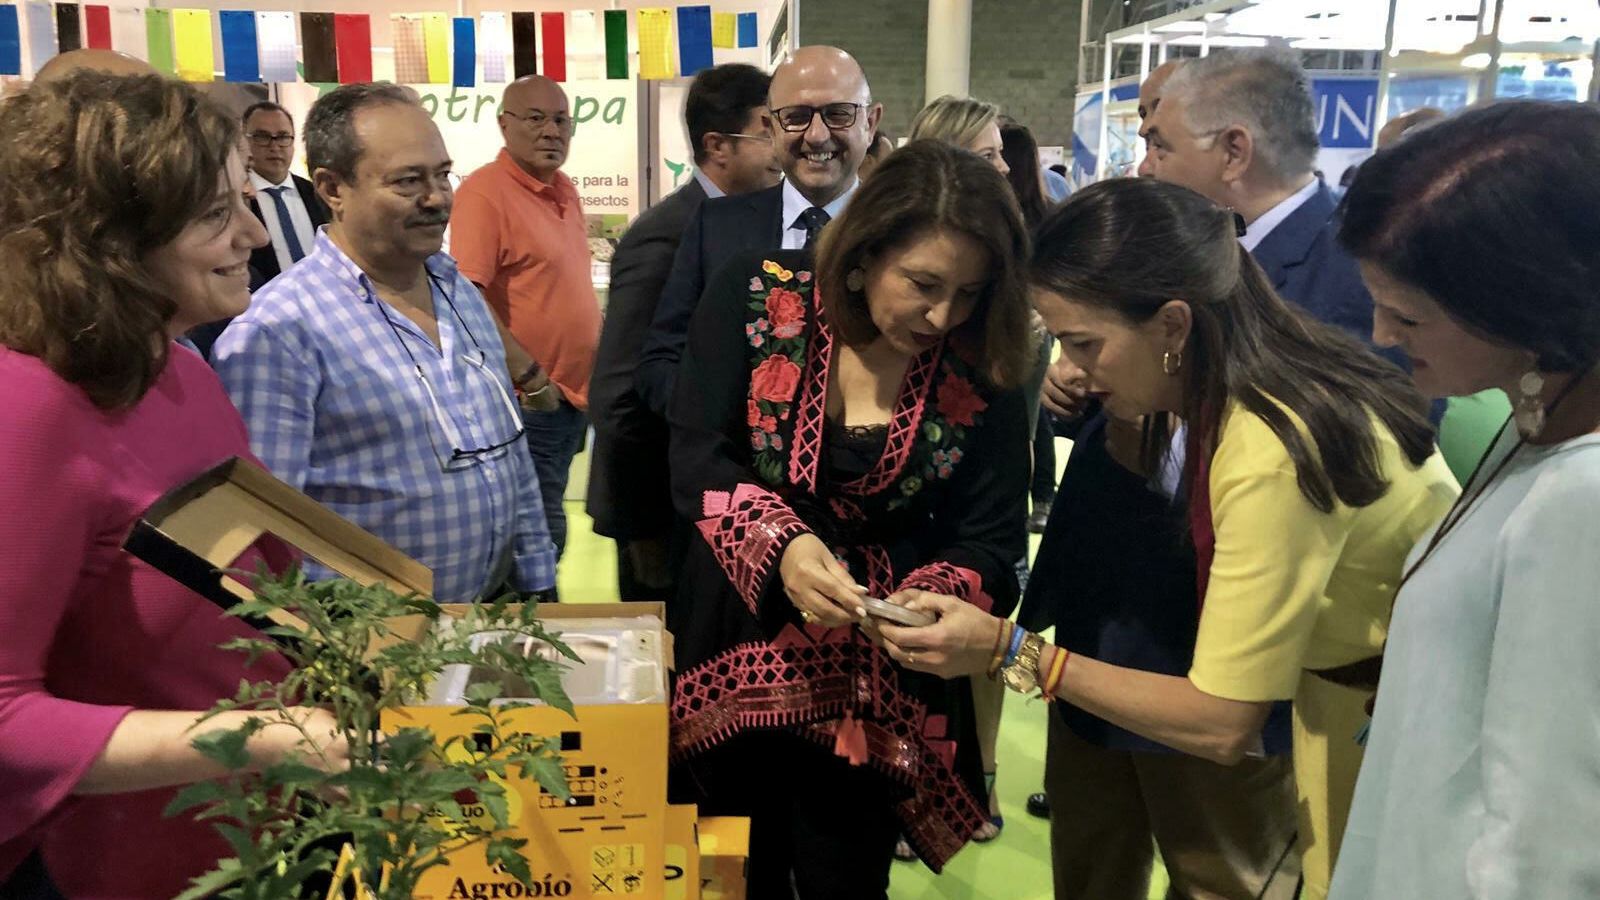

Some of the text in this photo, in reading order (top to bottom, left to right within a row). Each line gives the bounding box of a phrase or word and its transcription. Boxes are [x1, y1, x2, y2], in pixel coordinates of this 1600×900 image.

[583, 176, 612, 189] para
[617, 174, 629, 187] la
[578, 195, 629, 207] nsectos
